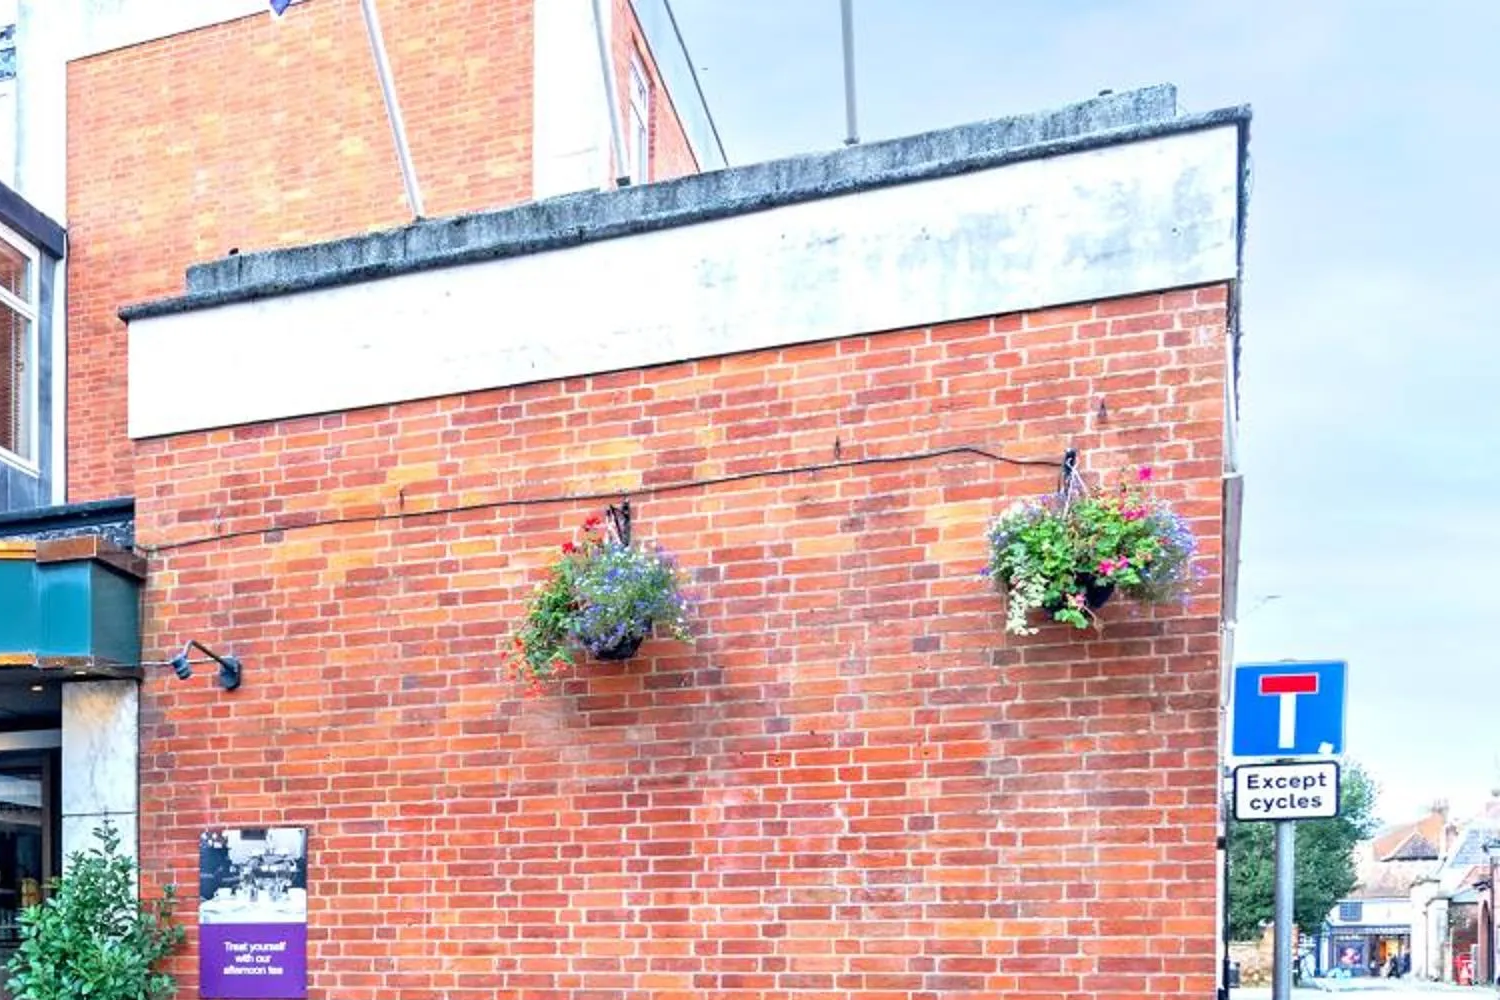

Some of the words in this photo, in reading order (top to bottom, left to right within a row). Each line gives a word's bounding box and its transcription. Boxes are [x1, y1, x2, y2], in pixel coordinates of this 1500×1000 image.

[1247, 771, 1328, 791] Except
[1249, 793, 1322, 813] cycles
[249, 941, 287, 953] yourself
[255, 955, 271, 963] our
[223, 965, 267, 975] afternoon
